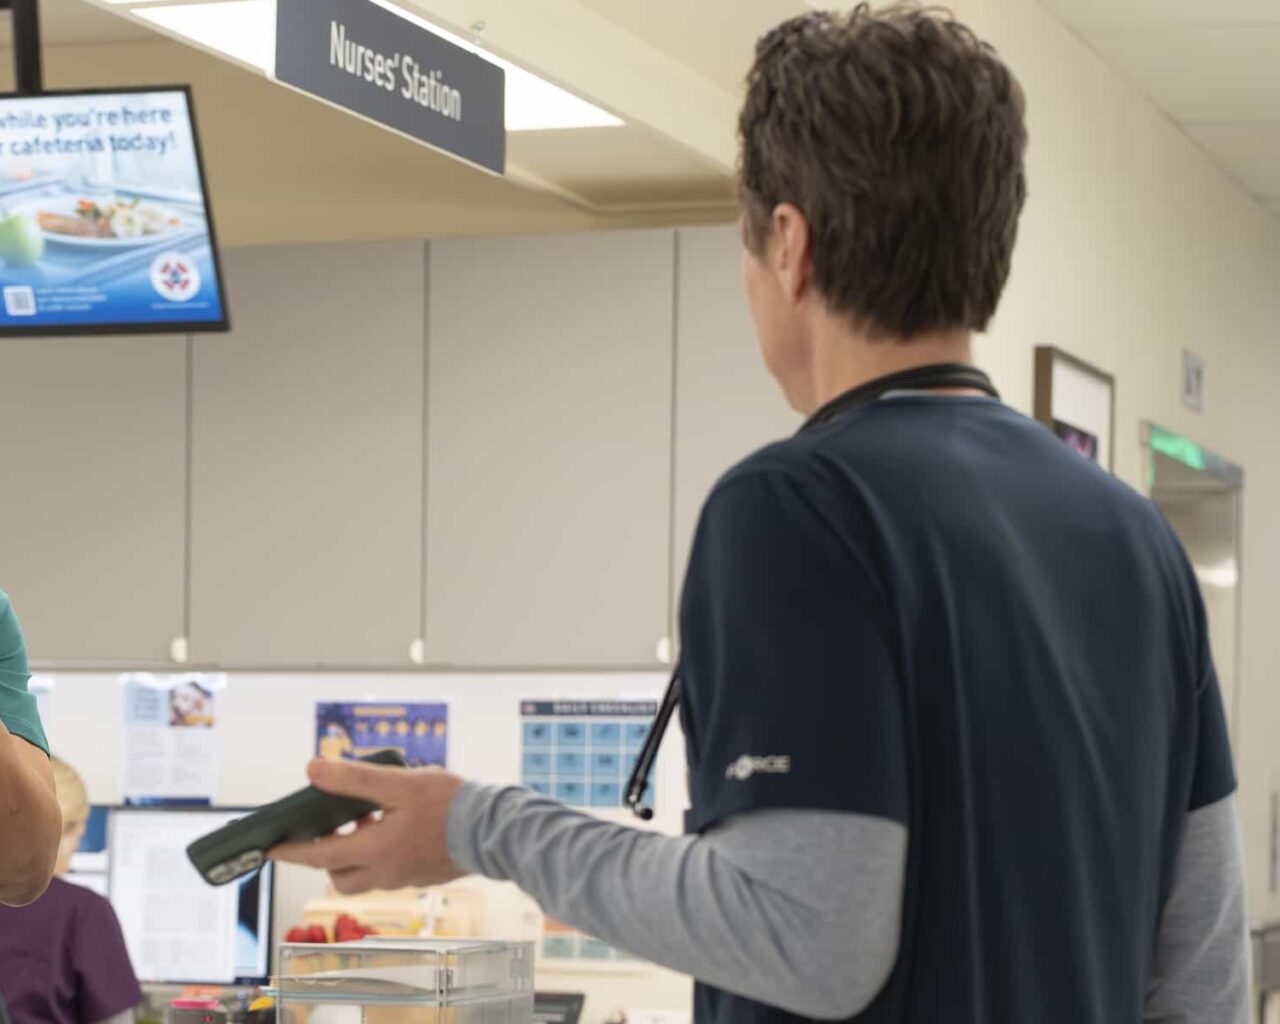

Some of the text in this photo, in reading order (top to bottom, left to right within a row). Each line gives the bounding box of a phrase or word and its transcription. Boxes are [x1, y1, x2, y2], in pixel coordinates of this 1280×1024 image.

[329, 20, 462, 121] Nurses' Station
[10, 136, 104, 155] cafeteria
[108, 131, 177, 156] today!
